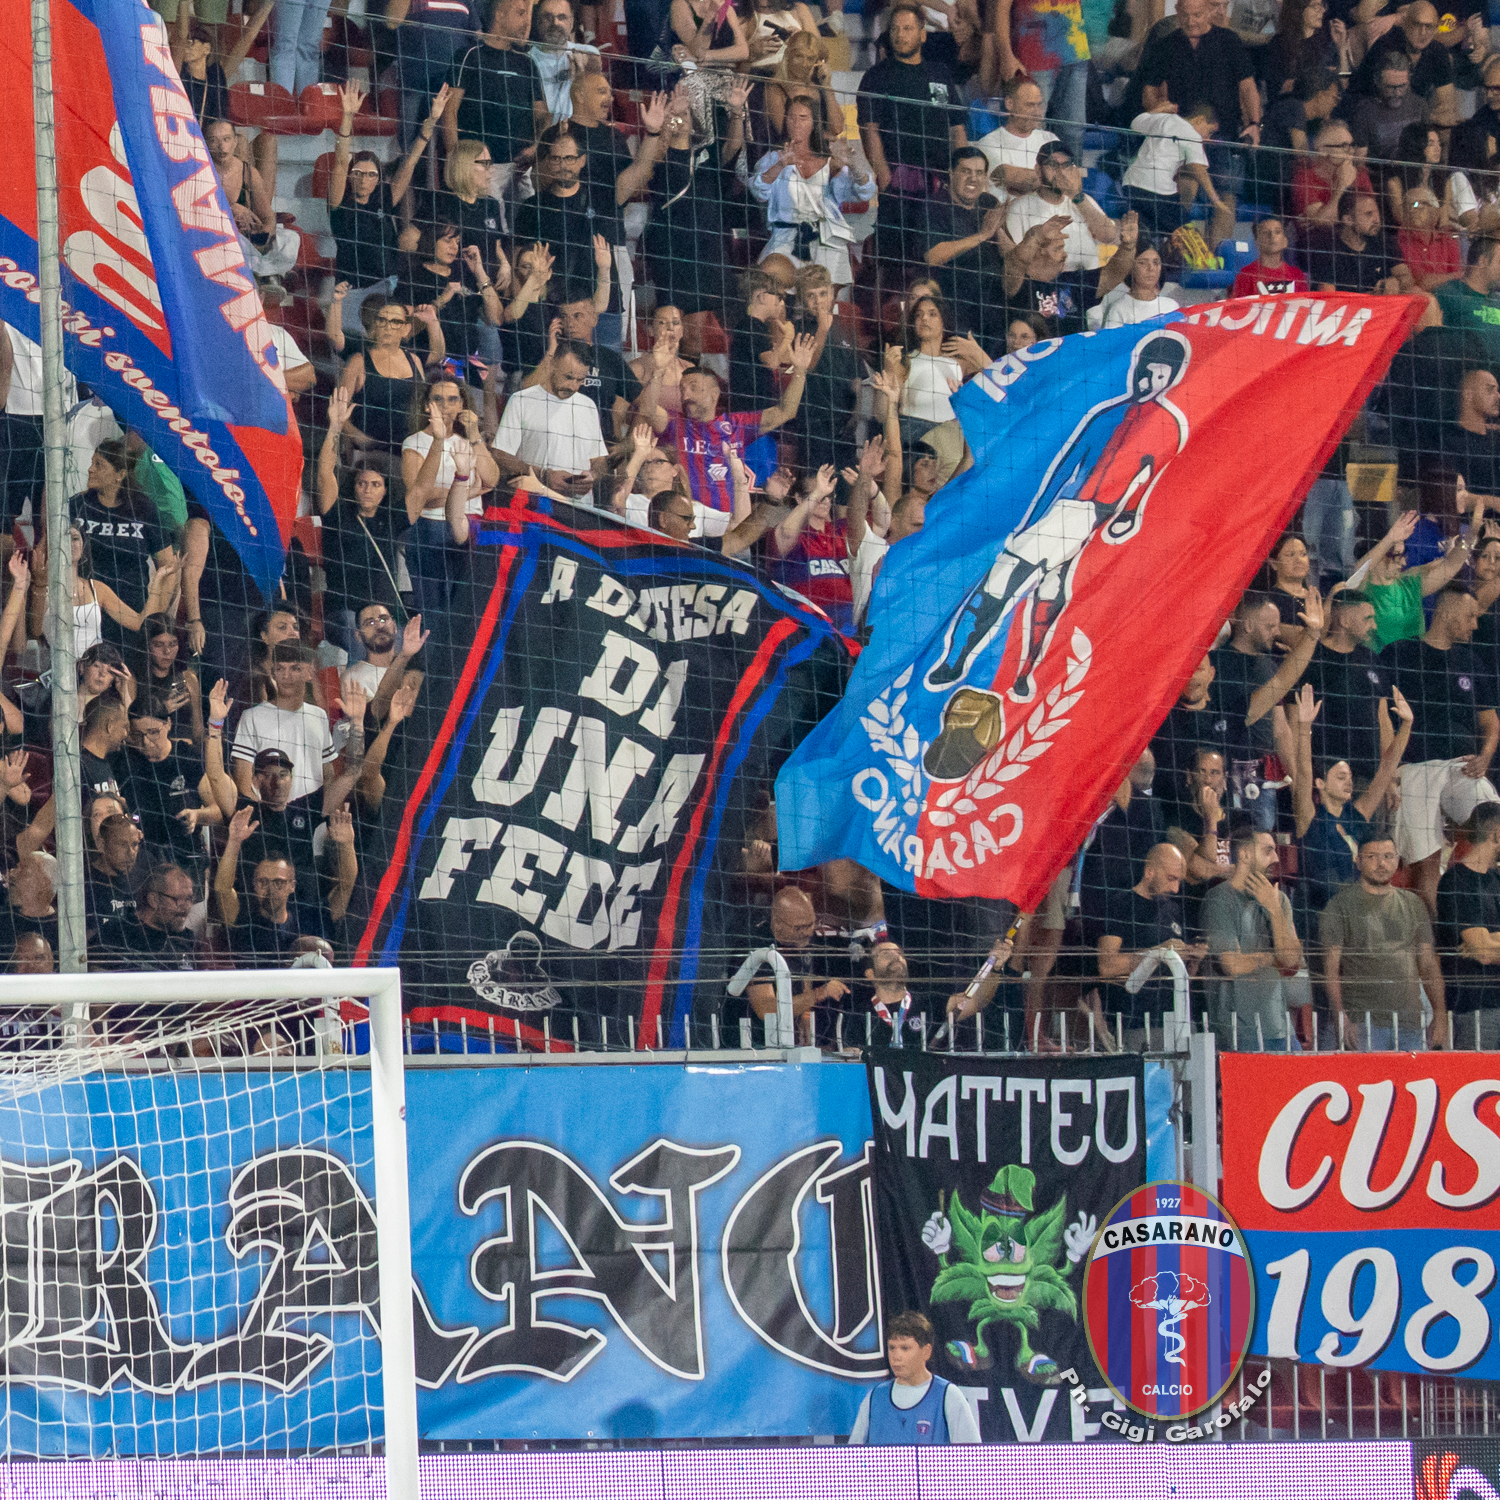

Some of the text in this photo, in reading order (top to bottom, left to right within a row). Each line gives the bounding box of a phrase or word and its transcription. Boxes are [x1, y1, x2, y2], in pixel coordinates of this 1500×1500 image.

[540, 556, 579, 604] A
[579, 632, 689, 740] DI
[470, 705, 706, 854] UNA
[418, 816, 662, 952] FEDE
[874, 1067, 1136, 1166] MATTEO
